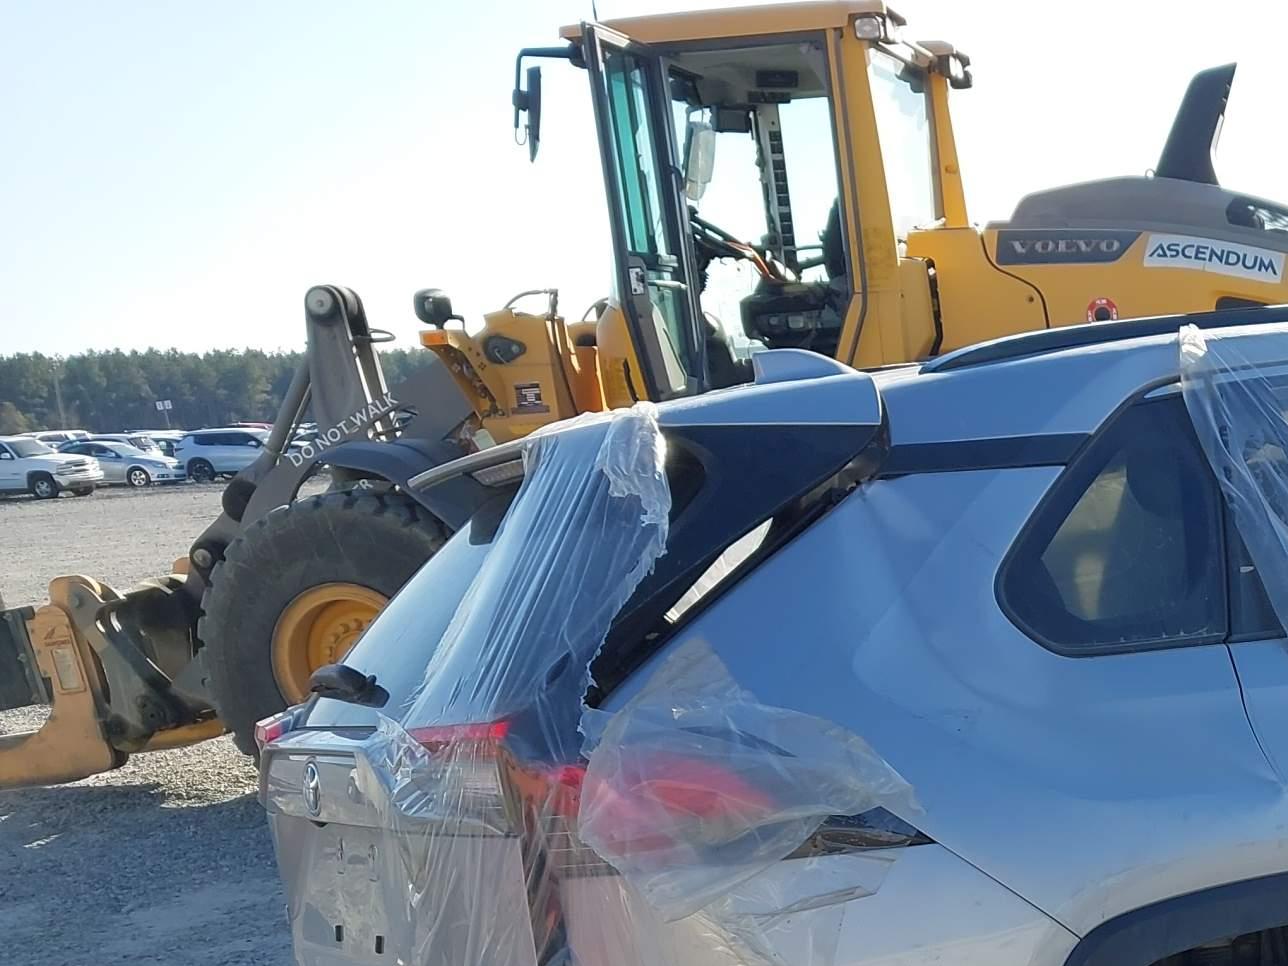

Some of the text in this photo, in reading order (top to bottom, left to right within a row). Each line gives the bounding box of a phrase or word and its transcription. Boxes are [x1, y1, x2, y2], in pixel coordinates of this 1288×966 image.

[1012, 240, 1120, 254] VOLVO
[1149, 243, 1277, 276] ASCENDUM
[289, 392, 399, 467] DO NOT WALK
